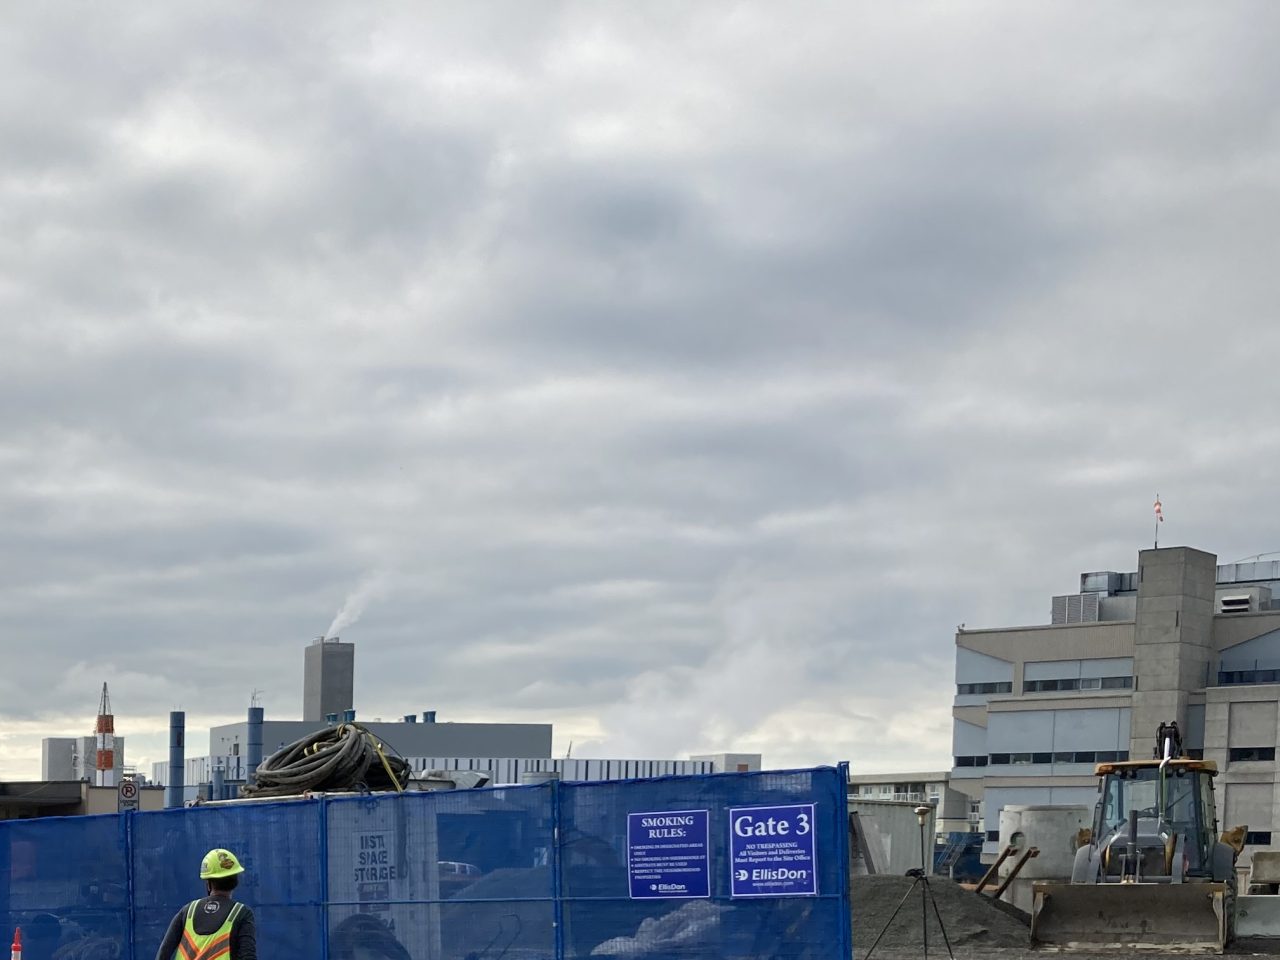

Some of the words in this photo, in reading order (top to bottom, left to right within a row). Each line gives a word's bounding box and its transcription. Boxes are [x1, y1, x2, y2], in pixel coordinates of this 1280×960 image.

[641, 816, 694, 827] SMOKING
[734, 816, 789, 837] Gate
[795, 813, 810, 835] 3
[648, 828, 687, 839] RULES:
[752, 868, 807, 880] EllisDon
